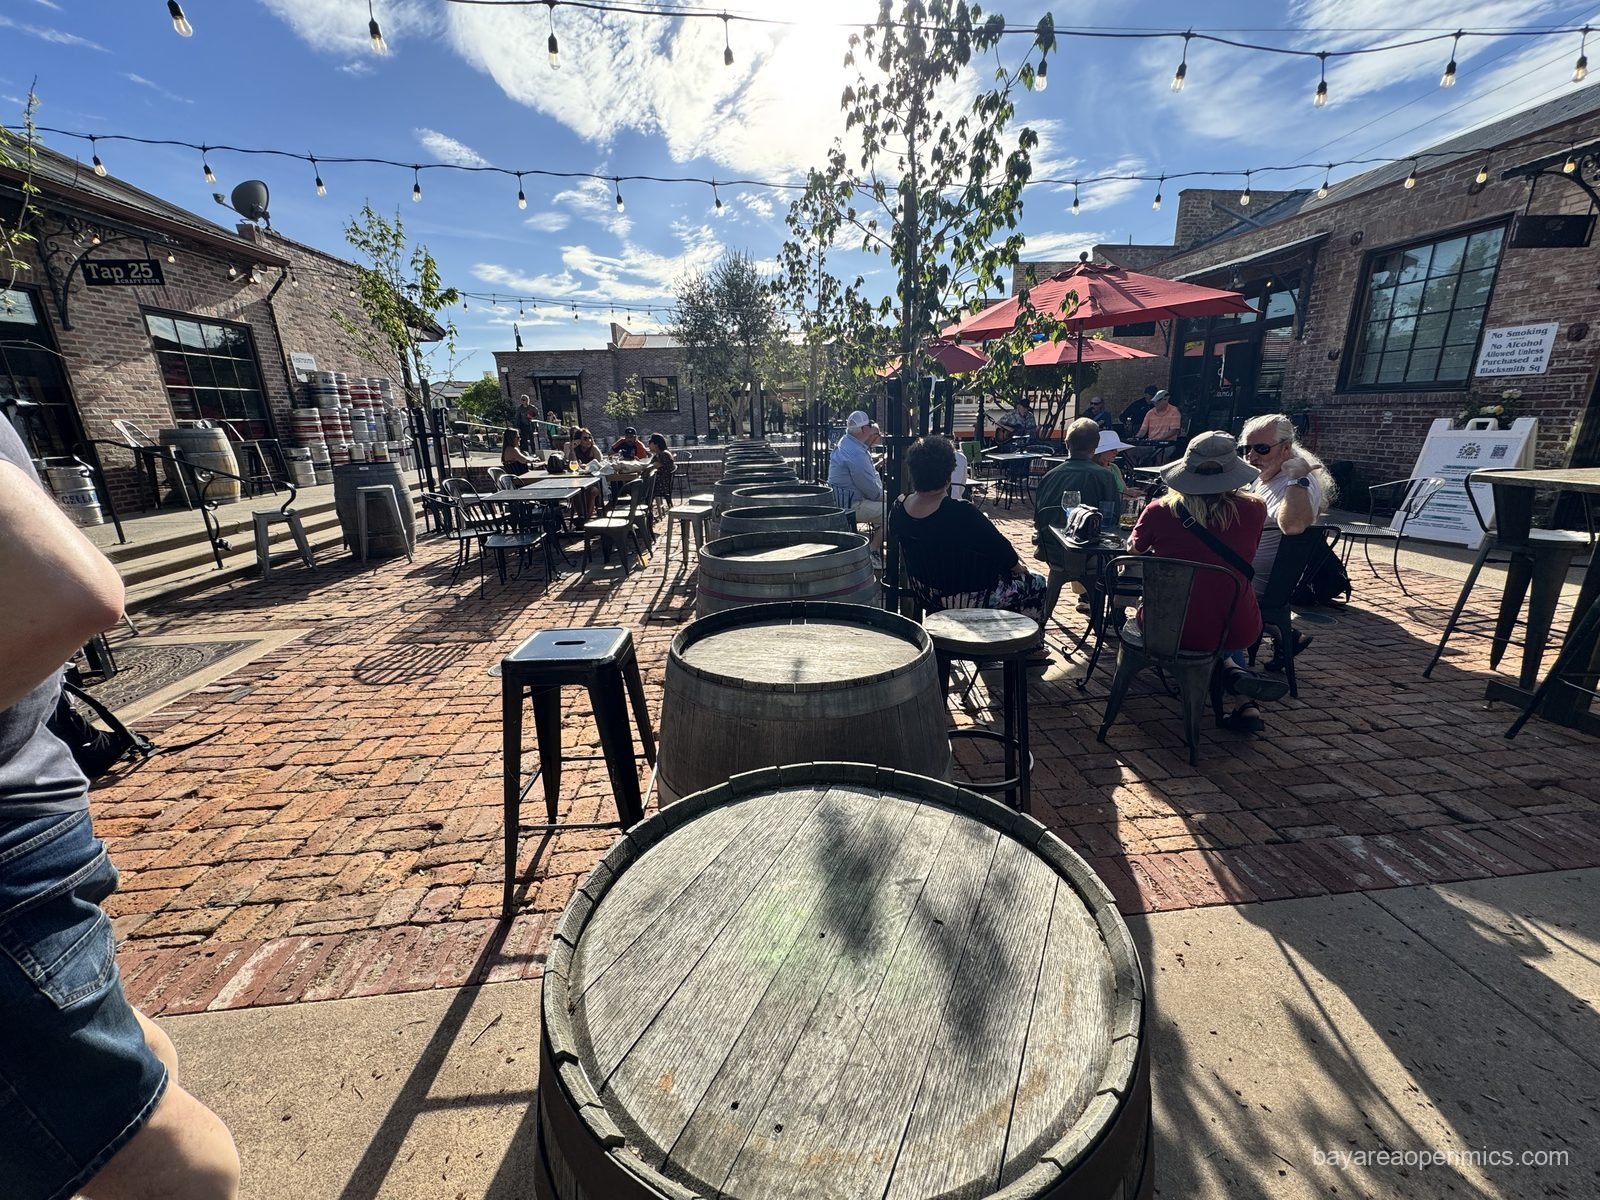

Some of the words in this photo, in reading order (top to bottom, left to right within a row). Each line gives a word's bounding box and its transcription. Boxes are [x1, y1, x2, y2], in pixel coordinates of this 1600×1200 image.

[84, 262, 124, 283] Tap
[127, 262, 153, 279] 25
[1506, 327, 1548, 337] Smoking
[1506, 339, 1543, 349] Alcohol
[1485, 350, 1515, 358] Allowed
[1518, 347, 1544, 355] Unless
[1482, 356, 1529, 366] Purchased
[1479, 365, 1525, 374] Blacksmith
[1529, 364, 1541, 373] Sq
